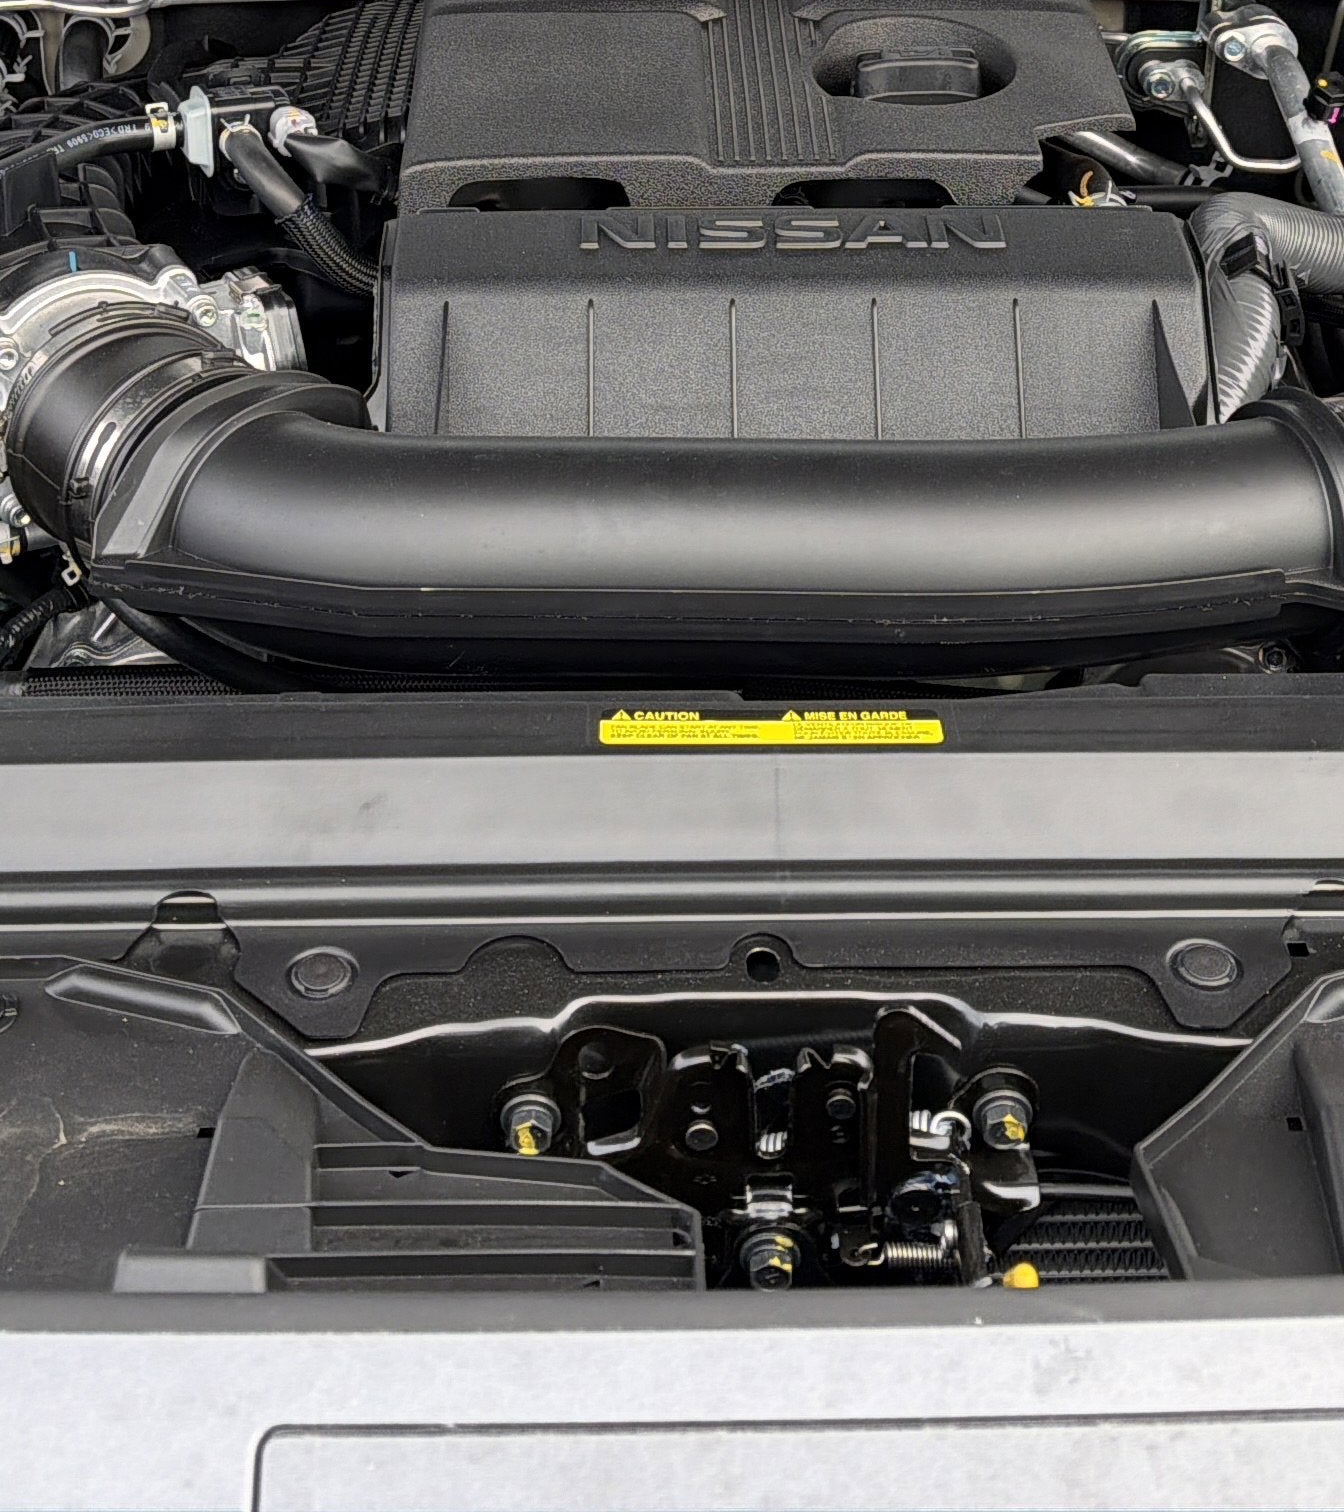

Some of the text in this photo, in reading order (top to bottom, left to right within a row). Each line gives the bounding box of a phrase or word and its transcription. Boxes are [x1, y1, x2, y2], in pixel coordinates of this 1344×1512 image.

[579, 213, 1007, 250] NISSAN
[633, 710, 700, 721] CAUTION
[803, 710, 908, 721] MISE EN GARDE
